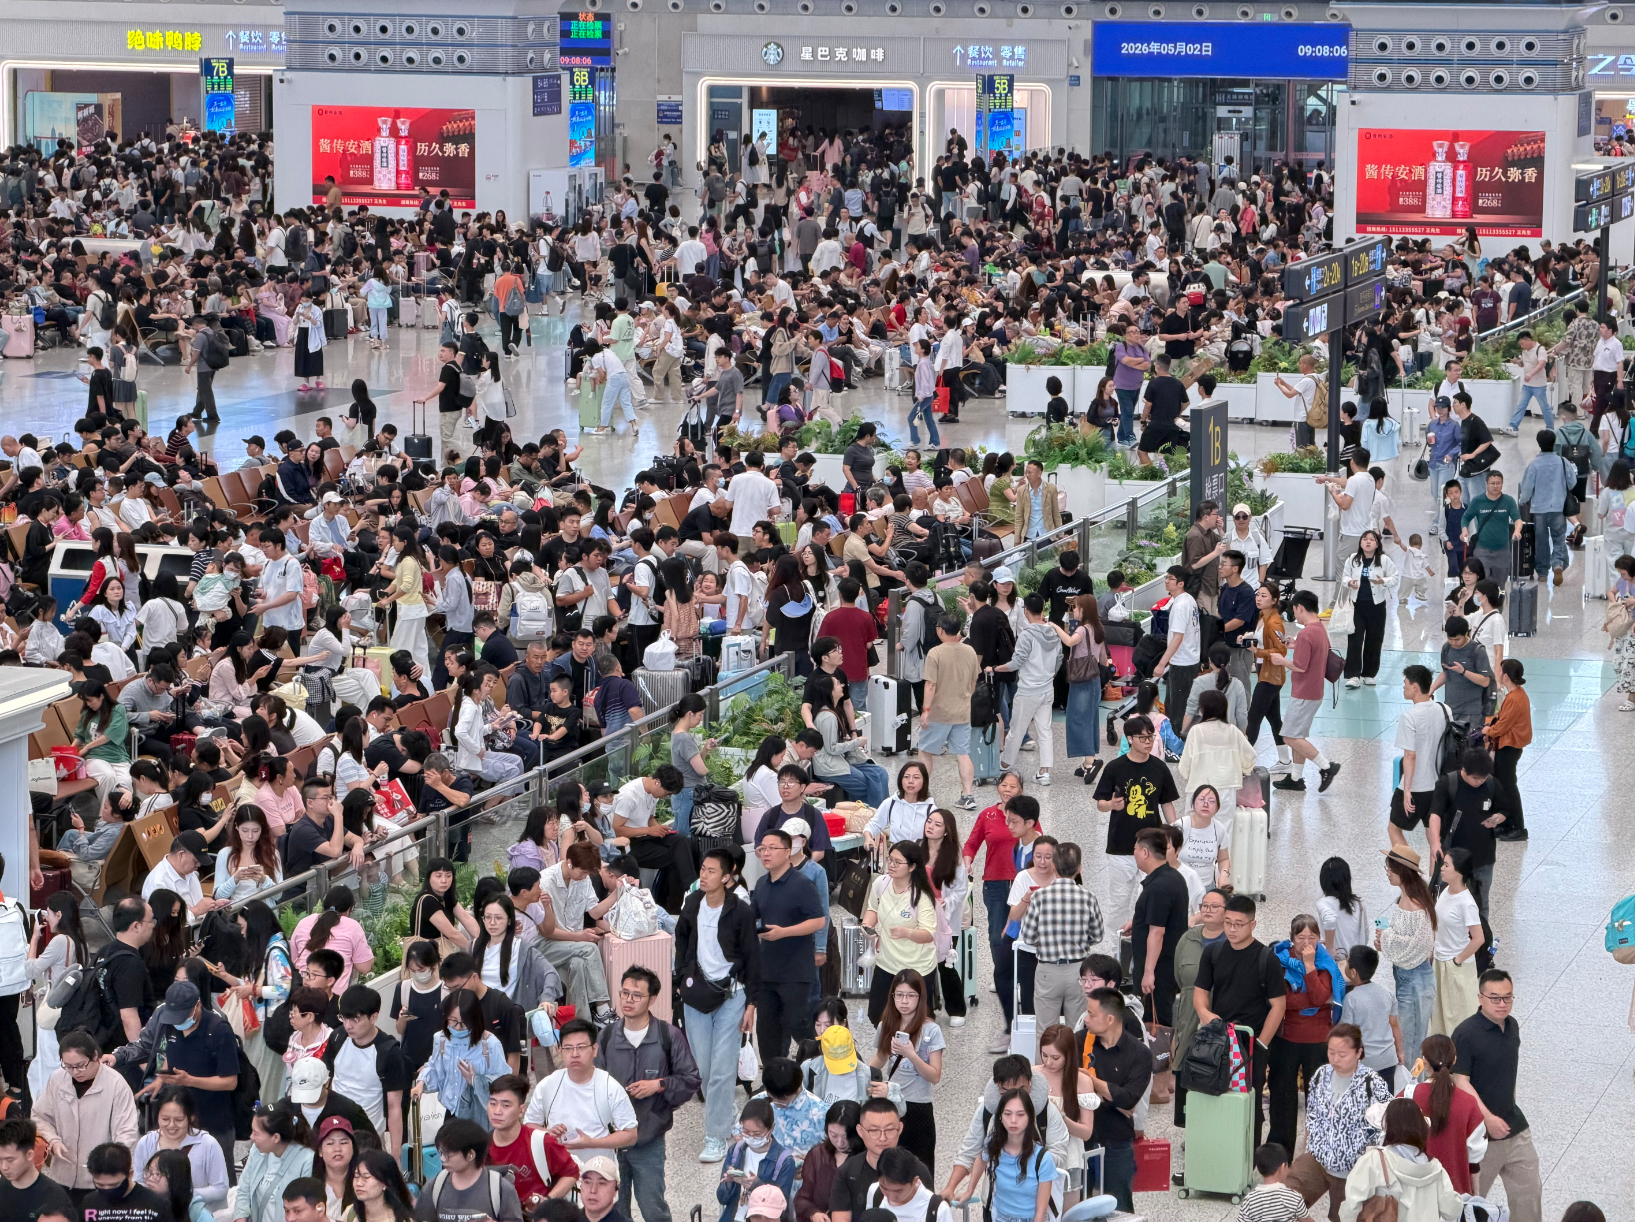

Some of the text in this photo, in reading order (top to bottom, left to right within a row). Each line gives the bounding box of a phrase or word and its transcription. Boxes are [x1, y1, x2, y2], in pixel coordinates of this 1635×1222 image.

[578, 13, 594, 21] 状态
[571, 21, 602, 30] 正在检票
[127, 30, 202, 50] 绝味鸭脖
[239, 31, 262, 44] 餐饮
[571, 30, 602, 38] 正在检票
[800, 46, 884, 62] 星巴克咖啡
[968, 46, 1026, 59] 餐饮 零售
[1121, 42, 1212, 56] 2026年05月02日
[1298, 46, 1348, 56] 09:08:06
[212, 63, 227, 76] 7B
[574, 72, 588, 85] 6B
[994, 80, 1008, 93] 5B
[319, 139, 372, 155] 酱传安酒
[416, 142, 470, 157] 历久弥香
[1365, 164, 1425, 180] 酱传安酒
[1476, 167, 1538, 183] 历久弥香
[1404, 197, 1418, 205] 388
[1482, 199, 1498, 207] 268
[1209, 416, 1221, 466] 1B
[1205, 472, 1224, 500] 检票口
